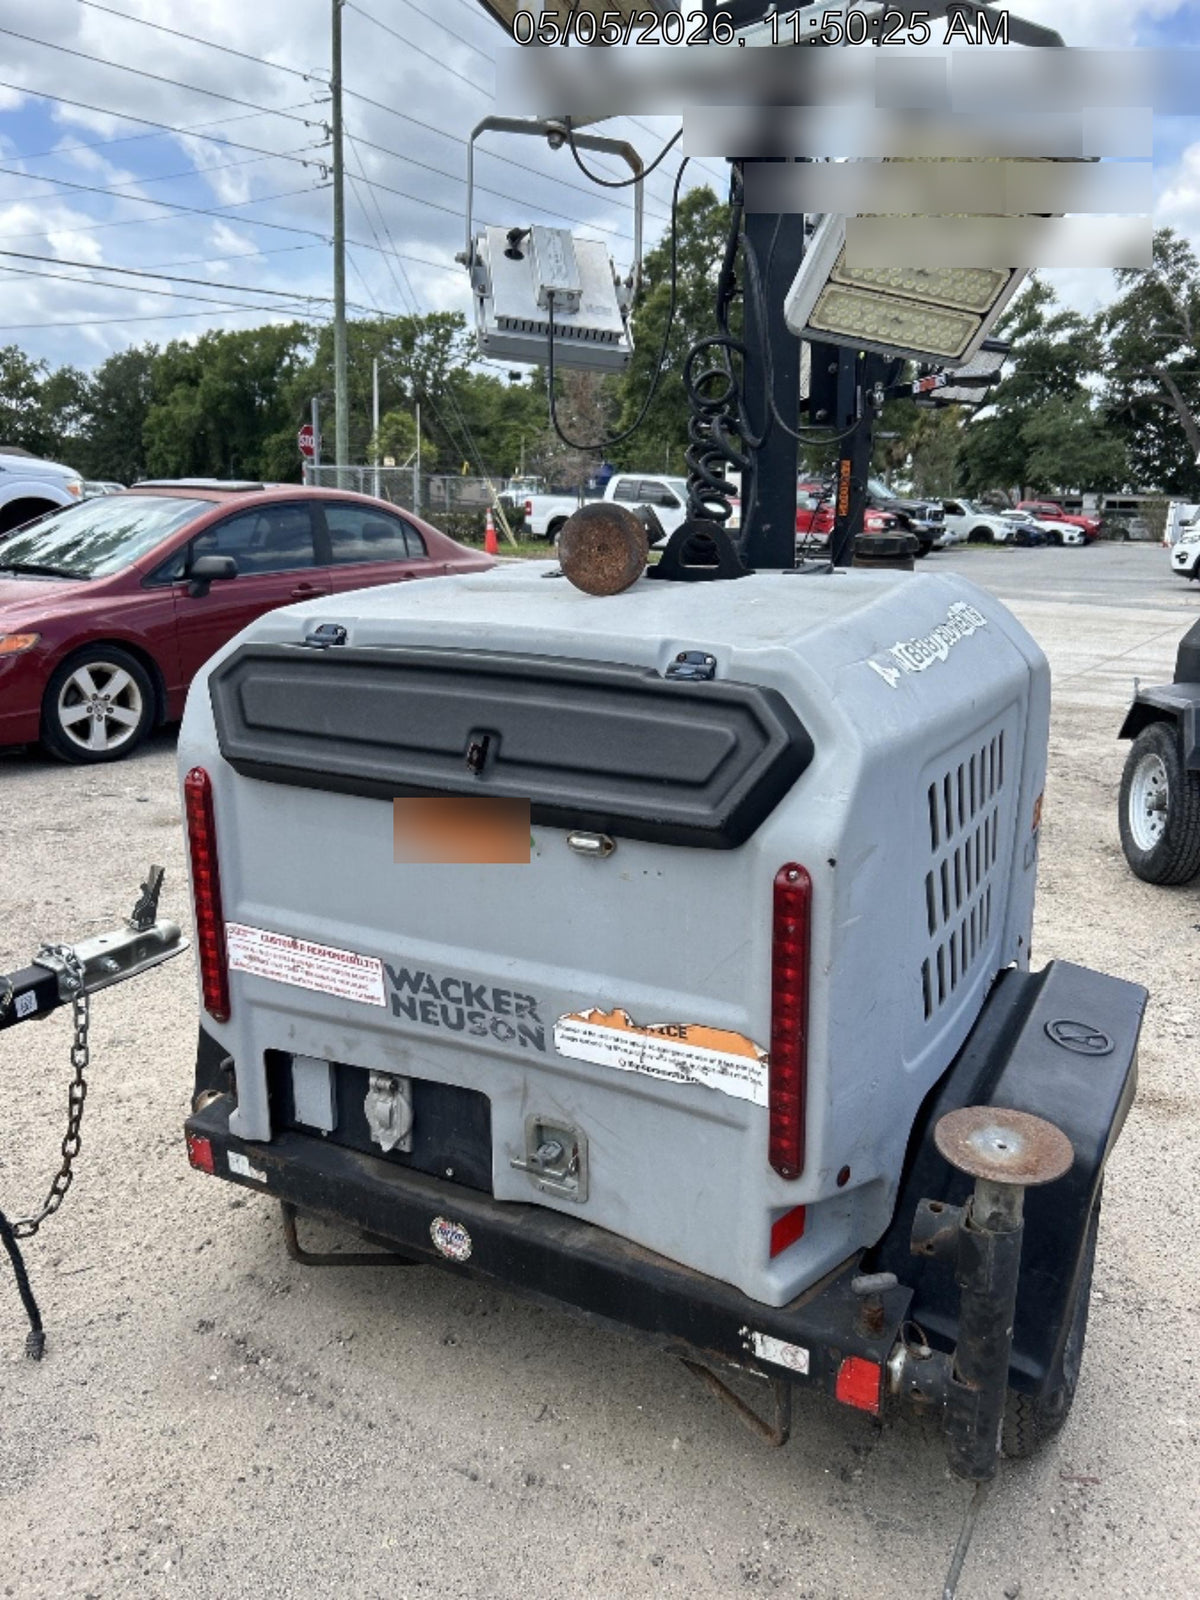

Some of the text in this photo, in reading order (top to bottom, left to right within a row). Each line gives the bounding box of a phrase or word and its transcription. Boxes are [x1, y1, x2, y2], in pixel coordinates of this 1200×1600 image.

[299, 435, 315, 447] STO
[383, 962, 543, 1024] WACKER
[390, 992, 547, 1053] NEUSON
